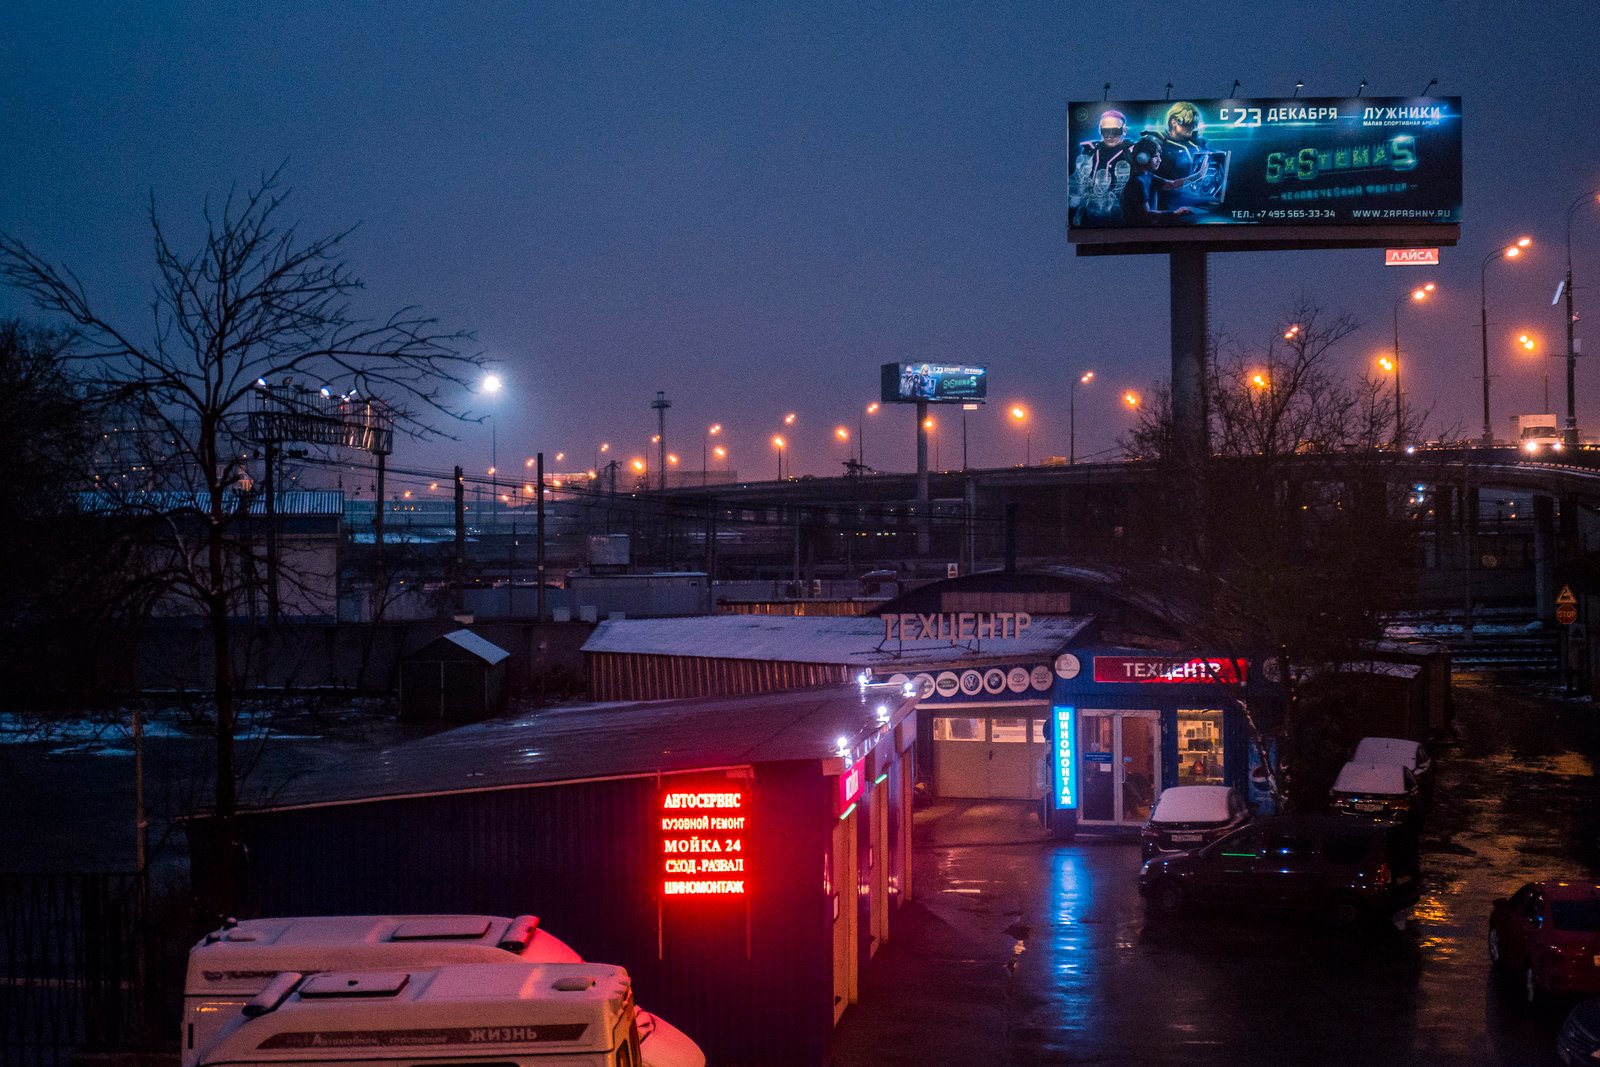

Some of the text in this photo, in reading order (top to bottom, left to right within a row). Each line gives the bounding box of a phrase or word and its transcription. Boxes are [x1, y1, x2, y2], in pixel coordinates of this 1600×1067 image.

[1220, 108, 1338, 127] С 23 ДЕКАБРЯ
[1363, 107, 1441, 120] ЛУЖНИКИ
[1257, 210, 1267, 218] +7
[1268, 210, 1286, 218] 495
[1287, 209, 1336, 218] 565-33-34
[1352, 209, 1451, 218] WWW.ZAPASHNY.RU
[1391, 249, 1433, 261] ЛАЙСА
[880, 611, 1032, 646] ТЕХЦЕНТР
[1058, 711, 1072, 805] ШИНОМОНТАЖ
[664, 793, 741, 808] АВТОСЕРВИС
[662, 815, 745, 830] КУЗОВНОЙ РЕМОНТ
[664, 836, 741, 852] МОЙКА 24
[665, 859, 744, 874] СХОД-РАЗВАЛ
[664, 881, 745, 894] ШИНОМОНТАЖ
[468, 1028, 537, 1042] ЖИЗНЬ
